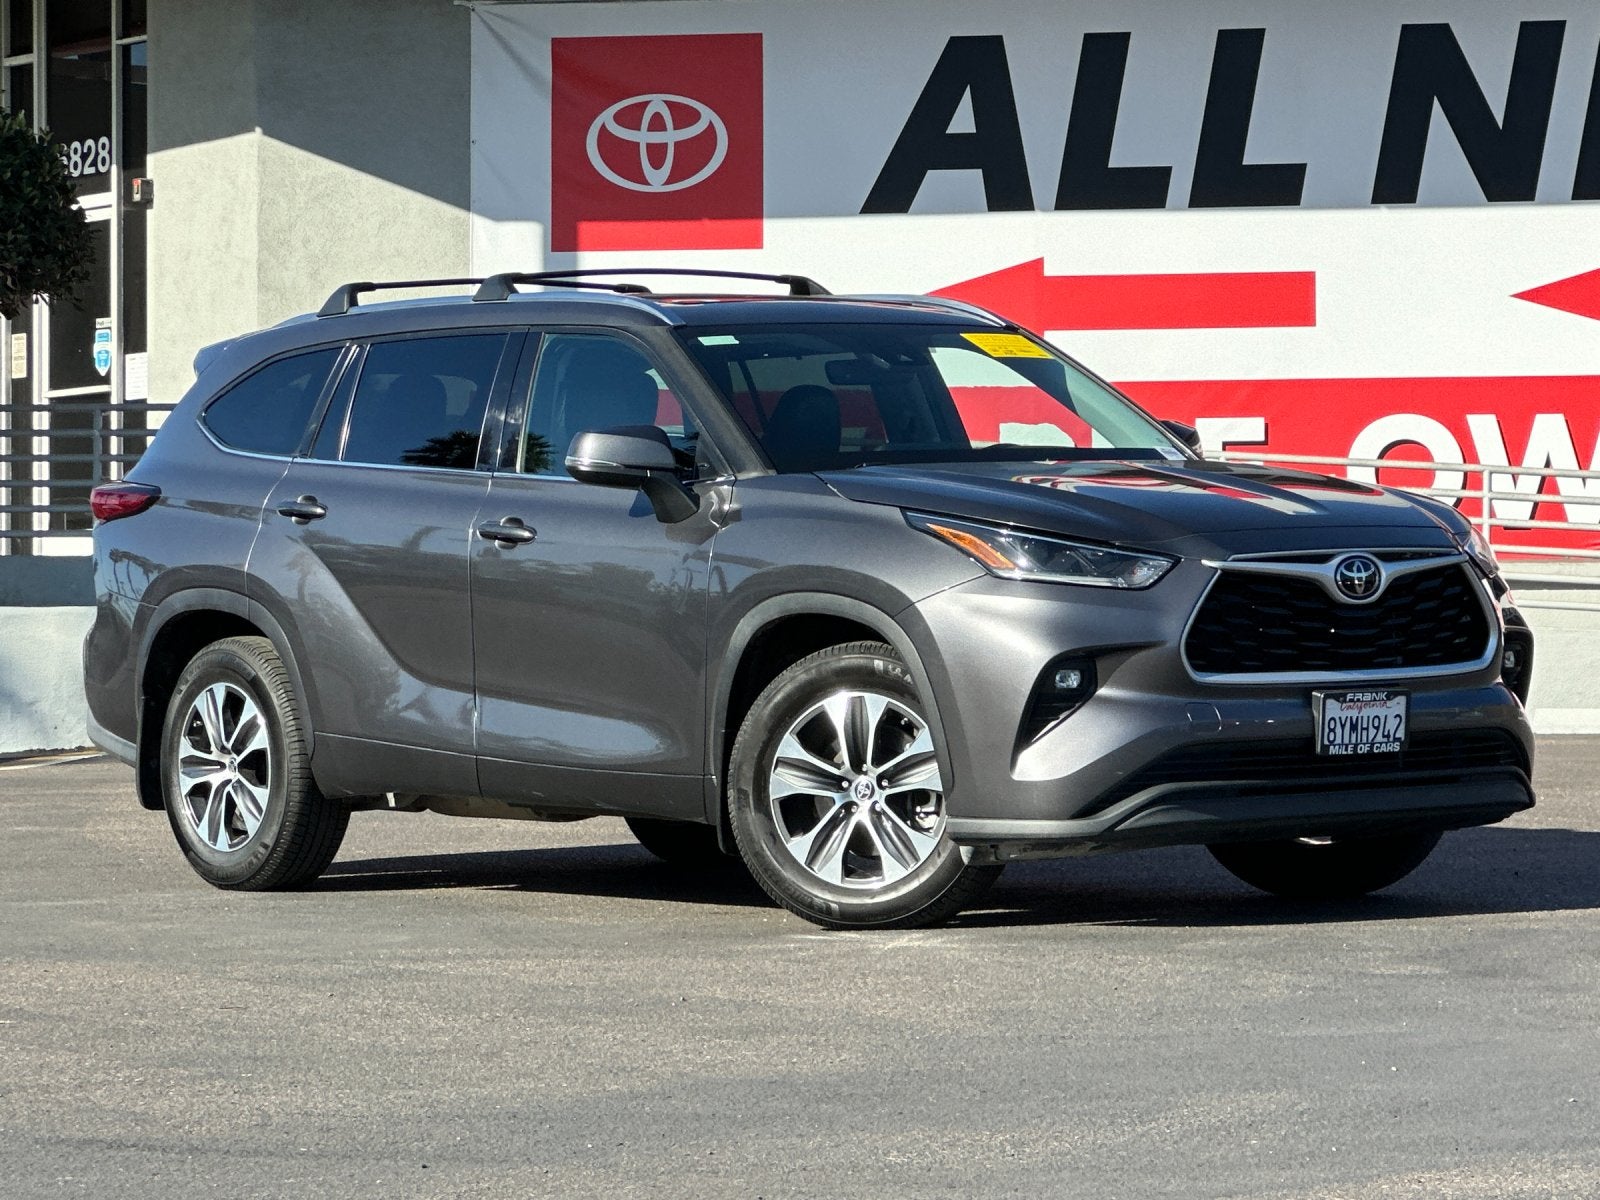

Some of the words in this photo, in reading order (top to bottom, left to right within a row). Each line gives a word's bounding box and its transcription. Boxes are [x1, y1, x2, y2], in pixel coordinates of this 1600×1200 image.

[859, 28, 1308, 214] ALL
[1371, 20, 1600, 205] N
[1340, 701, 1392, 714] California
[1327, 713, 1402, 744] 8YMH942
[1329, 744, 1354, 755] MILE
[1357, 743, 1370, 754] OF
[1373, 742, 1400, 753] CARS
